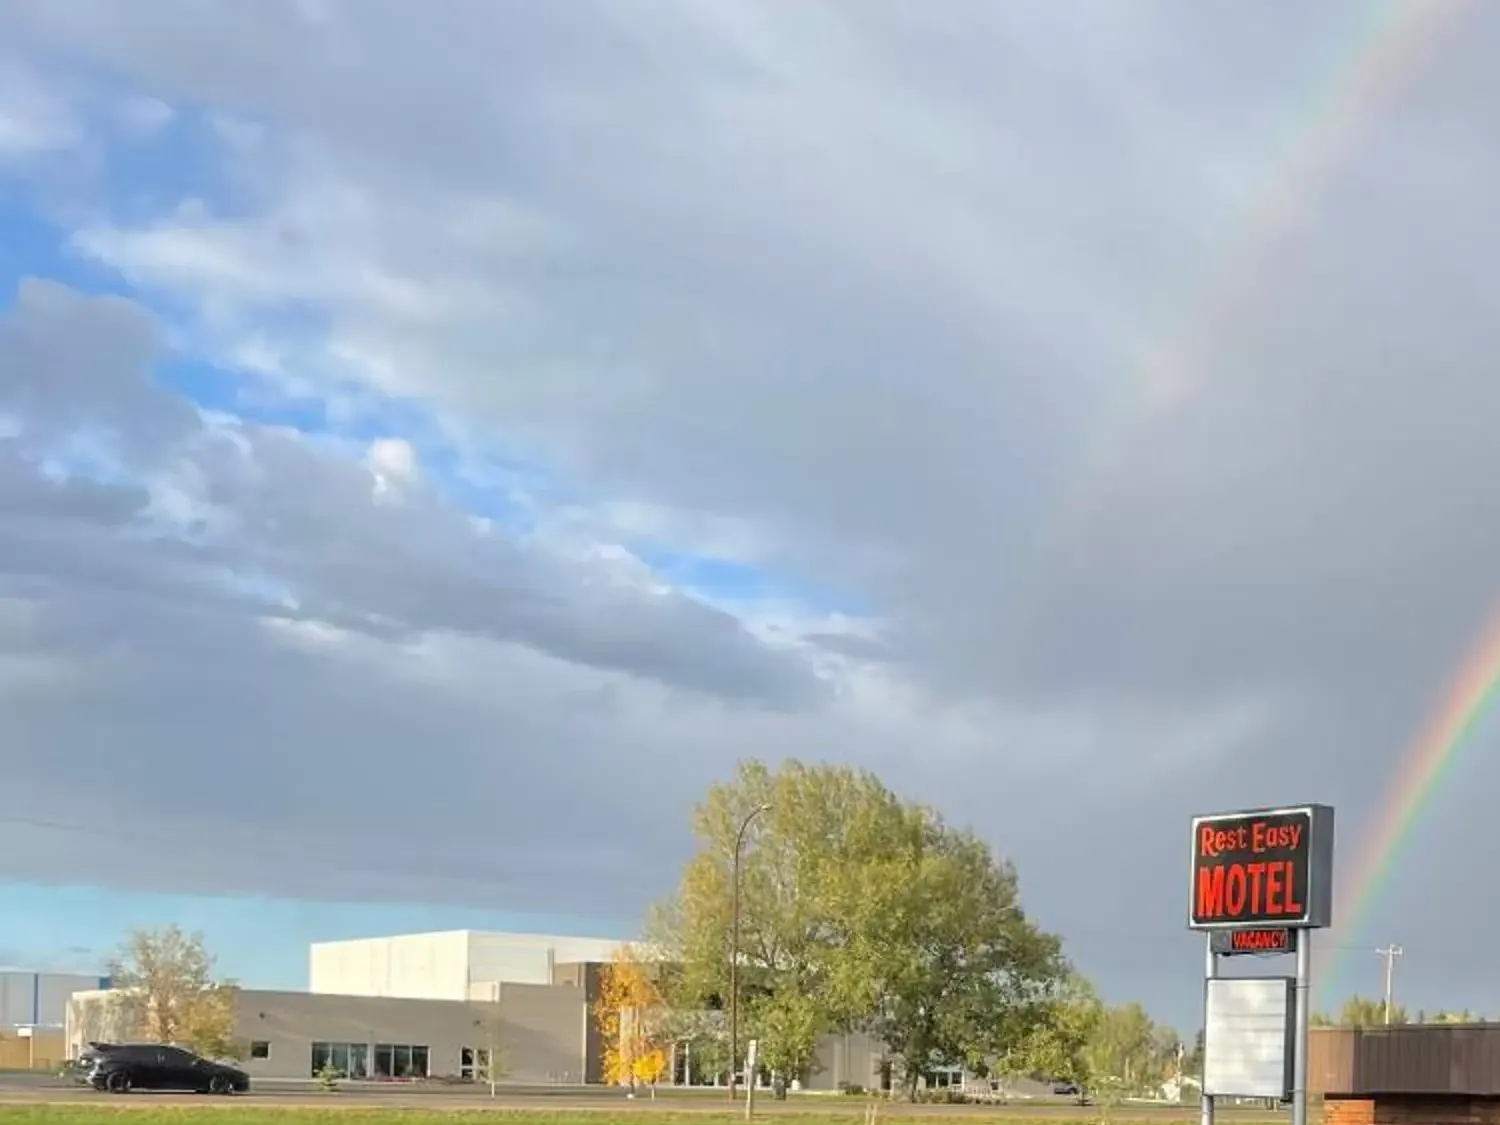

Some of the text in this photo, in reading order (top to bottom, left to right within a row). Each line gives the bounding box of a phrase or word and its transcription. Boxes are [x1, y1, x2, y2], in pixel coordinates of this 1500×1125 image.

[1201, 822, 1302, 857] Rest Easy
[1198, 862, 1302, 917] MOTEL
[1233, 931, 1285, 948] VACANCY
